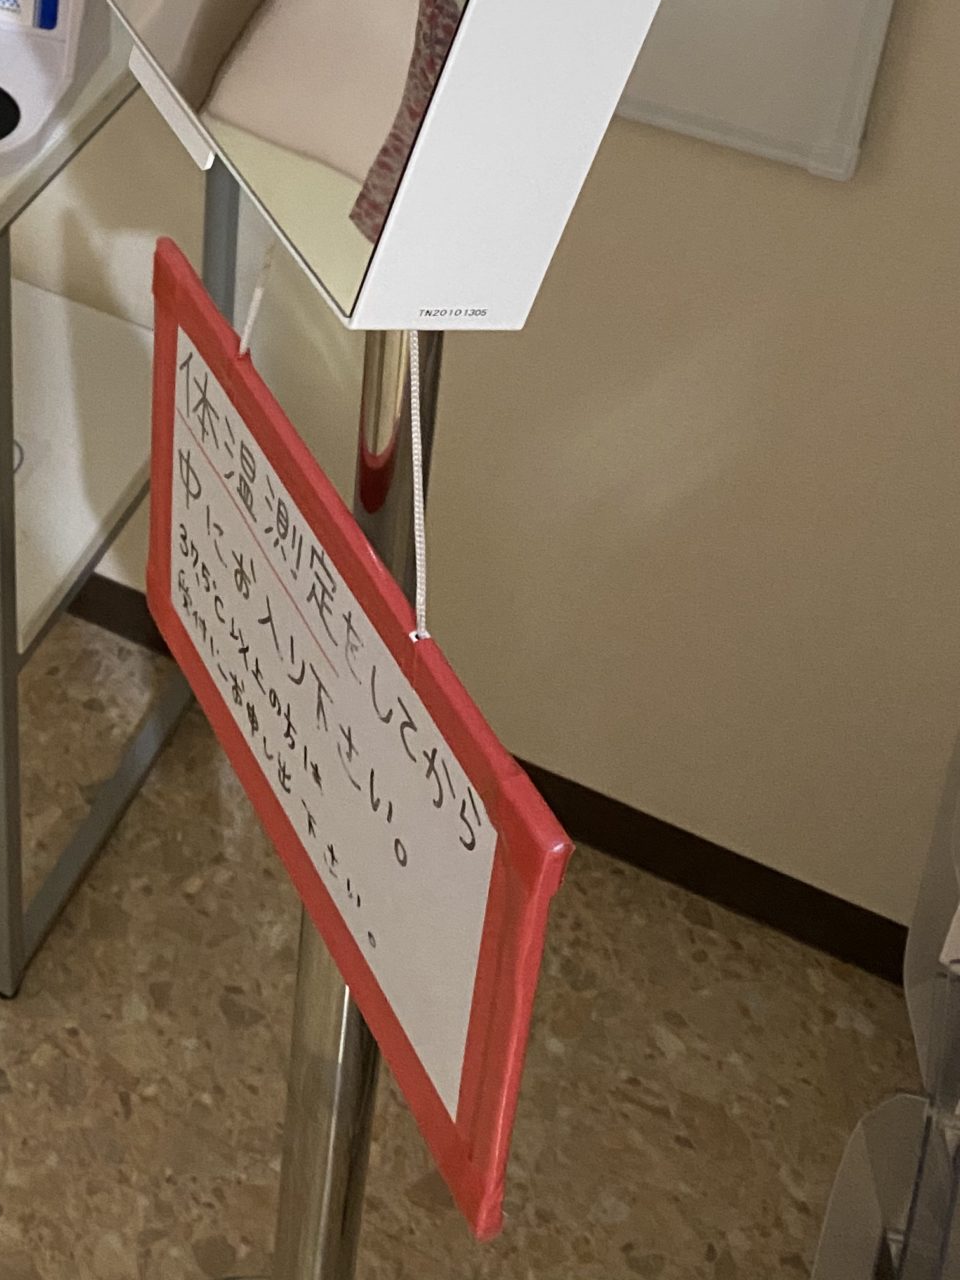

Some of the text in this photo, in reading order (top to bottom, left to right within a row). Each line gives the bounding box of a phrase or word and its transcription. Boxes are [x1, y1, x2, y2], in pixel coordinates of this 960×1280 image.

[419, 308, 488, 318] TN20101305
[178, 448, 409, 869] 中にお入り下さい。
[179, 352, 482, 853] 体温測定をしてから
